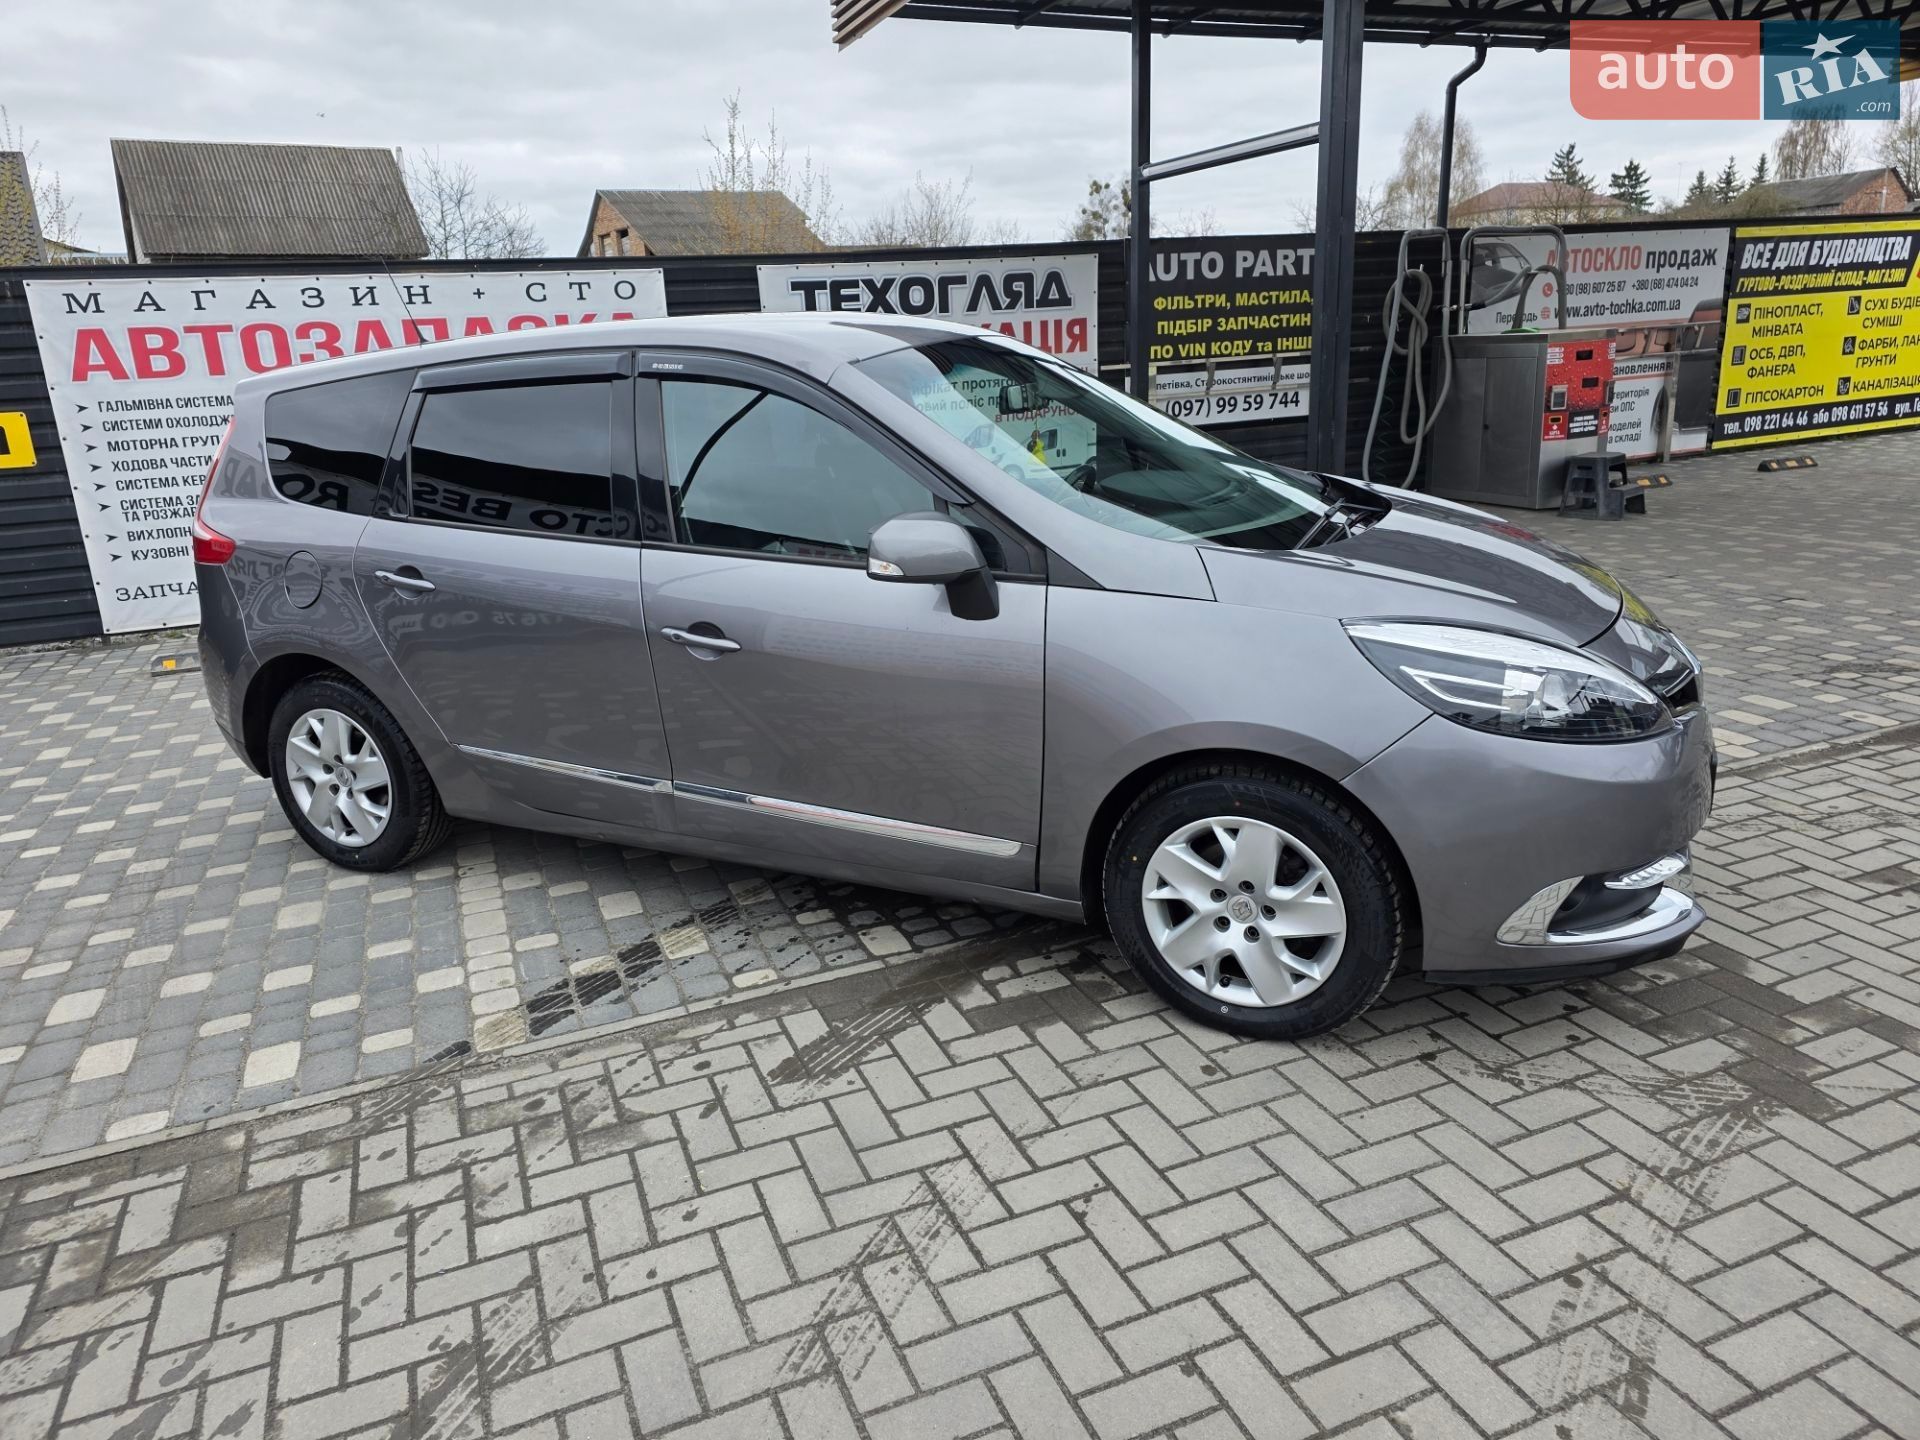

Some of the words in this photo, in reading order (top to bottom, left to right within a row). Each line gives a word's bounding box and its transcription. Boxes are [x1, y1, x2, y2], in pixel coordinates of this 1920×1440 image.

[1645, 248, 1719, 273] продаж
[1740, 242, 1774, 269] ВСЕ
[1771, 241, 1810, 270] ДЛЯ
[1809, 236, 1912, 267] БУДІВНИЦТВА
[1235, 248, 1315, 278] PART
[62, 284, 433, 314] МАГАЗИН
[525, 280, 637, 302] СТО
[790, 270, 1073, 316] ТЕХОГЛЯД
[1153, 293, 1231, 310] ФІЛЬТРИ,
[1235, 289, 1314, 306] МАСТИЛА,
[1754, 303, 1824, 320] ПІНОПЛАСТ,
[1864, 298, 1888, 311] СУХІ
[1157, 318, 1213, 336] ПІДБІР
[1217, 312, 1312, 331] ЗАПЧАСТИН
[1751, 323, 1803, 338] МІНВАТА
[1862, 315, 1902, 329] СУМІШІ
[1150, 345, 1173, 359] ПО
[1178, 342, 1206, 357] VIN
[1211, 340, 1252, 355] КОДУ
[1257, 342, 1273, 352] та
[1749, 347, 1776, 361] ОСБ,
[1778, 344, 1806, 360] ДВП,
[1858, 337, 1899, 350] ФАРБИ,
[1856, 353, 1897, 368] ГРУНТИ
[1747, 363, 1795, 379] ФАНЕРА
[1745, 385, 1824, 404] ГІПСОКАРТОН
[98, 398, 173, 413] ГАЛЬМІВНА
[175, 395, 234, 409] СИСТЕМА
[1165, 397, 1211, 418] (097)
[1216, 396, 1238, 414] 99
[1242, 394, 1263, 411] 59
[1268, 391, 1300, 409] 744
[102, 417, 163, 432] СИСТЕМИ
[166, 414, 235, 429] ОХОЛОДЖ
[1724, 421, 1742, 434] тел.
[1744, 416, 1762, 432] 098
[1763, 414, 1780, 430] 221
[1781, 412, 1794, 427] 64
[1796, 410, 1808, 426] 46
[1812, 408, 1829, 424] або
[1831, 405, 1849, 422] 098
[1849, 404, 1863, 420] 611
[1864, 402, 1876, 418] 57
[1877, 401, 1889, 416] 56
[1894, 401, 1911, 418] вул.
[107, 437, 179, 452] МОТОРНА
[182, 434, 223, 447] ГРУП
[111, 458, 168, 472] ХОДОВА
[170, 455, 214, 468] ЧАСТИ
[115, 476, 180, 491] СИСТЕМА
[120, 496, 184, 511] СИСТЕМА
[122, 511, 140, 522] ТА
[131, 546, 190, 561] КУЗОВНІ
